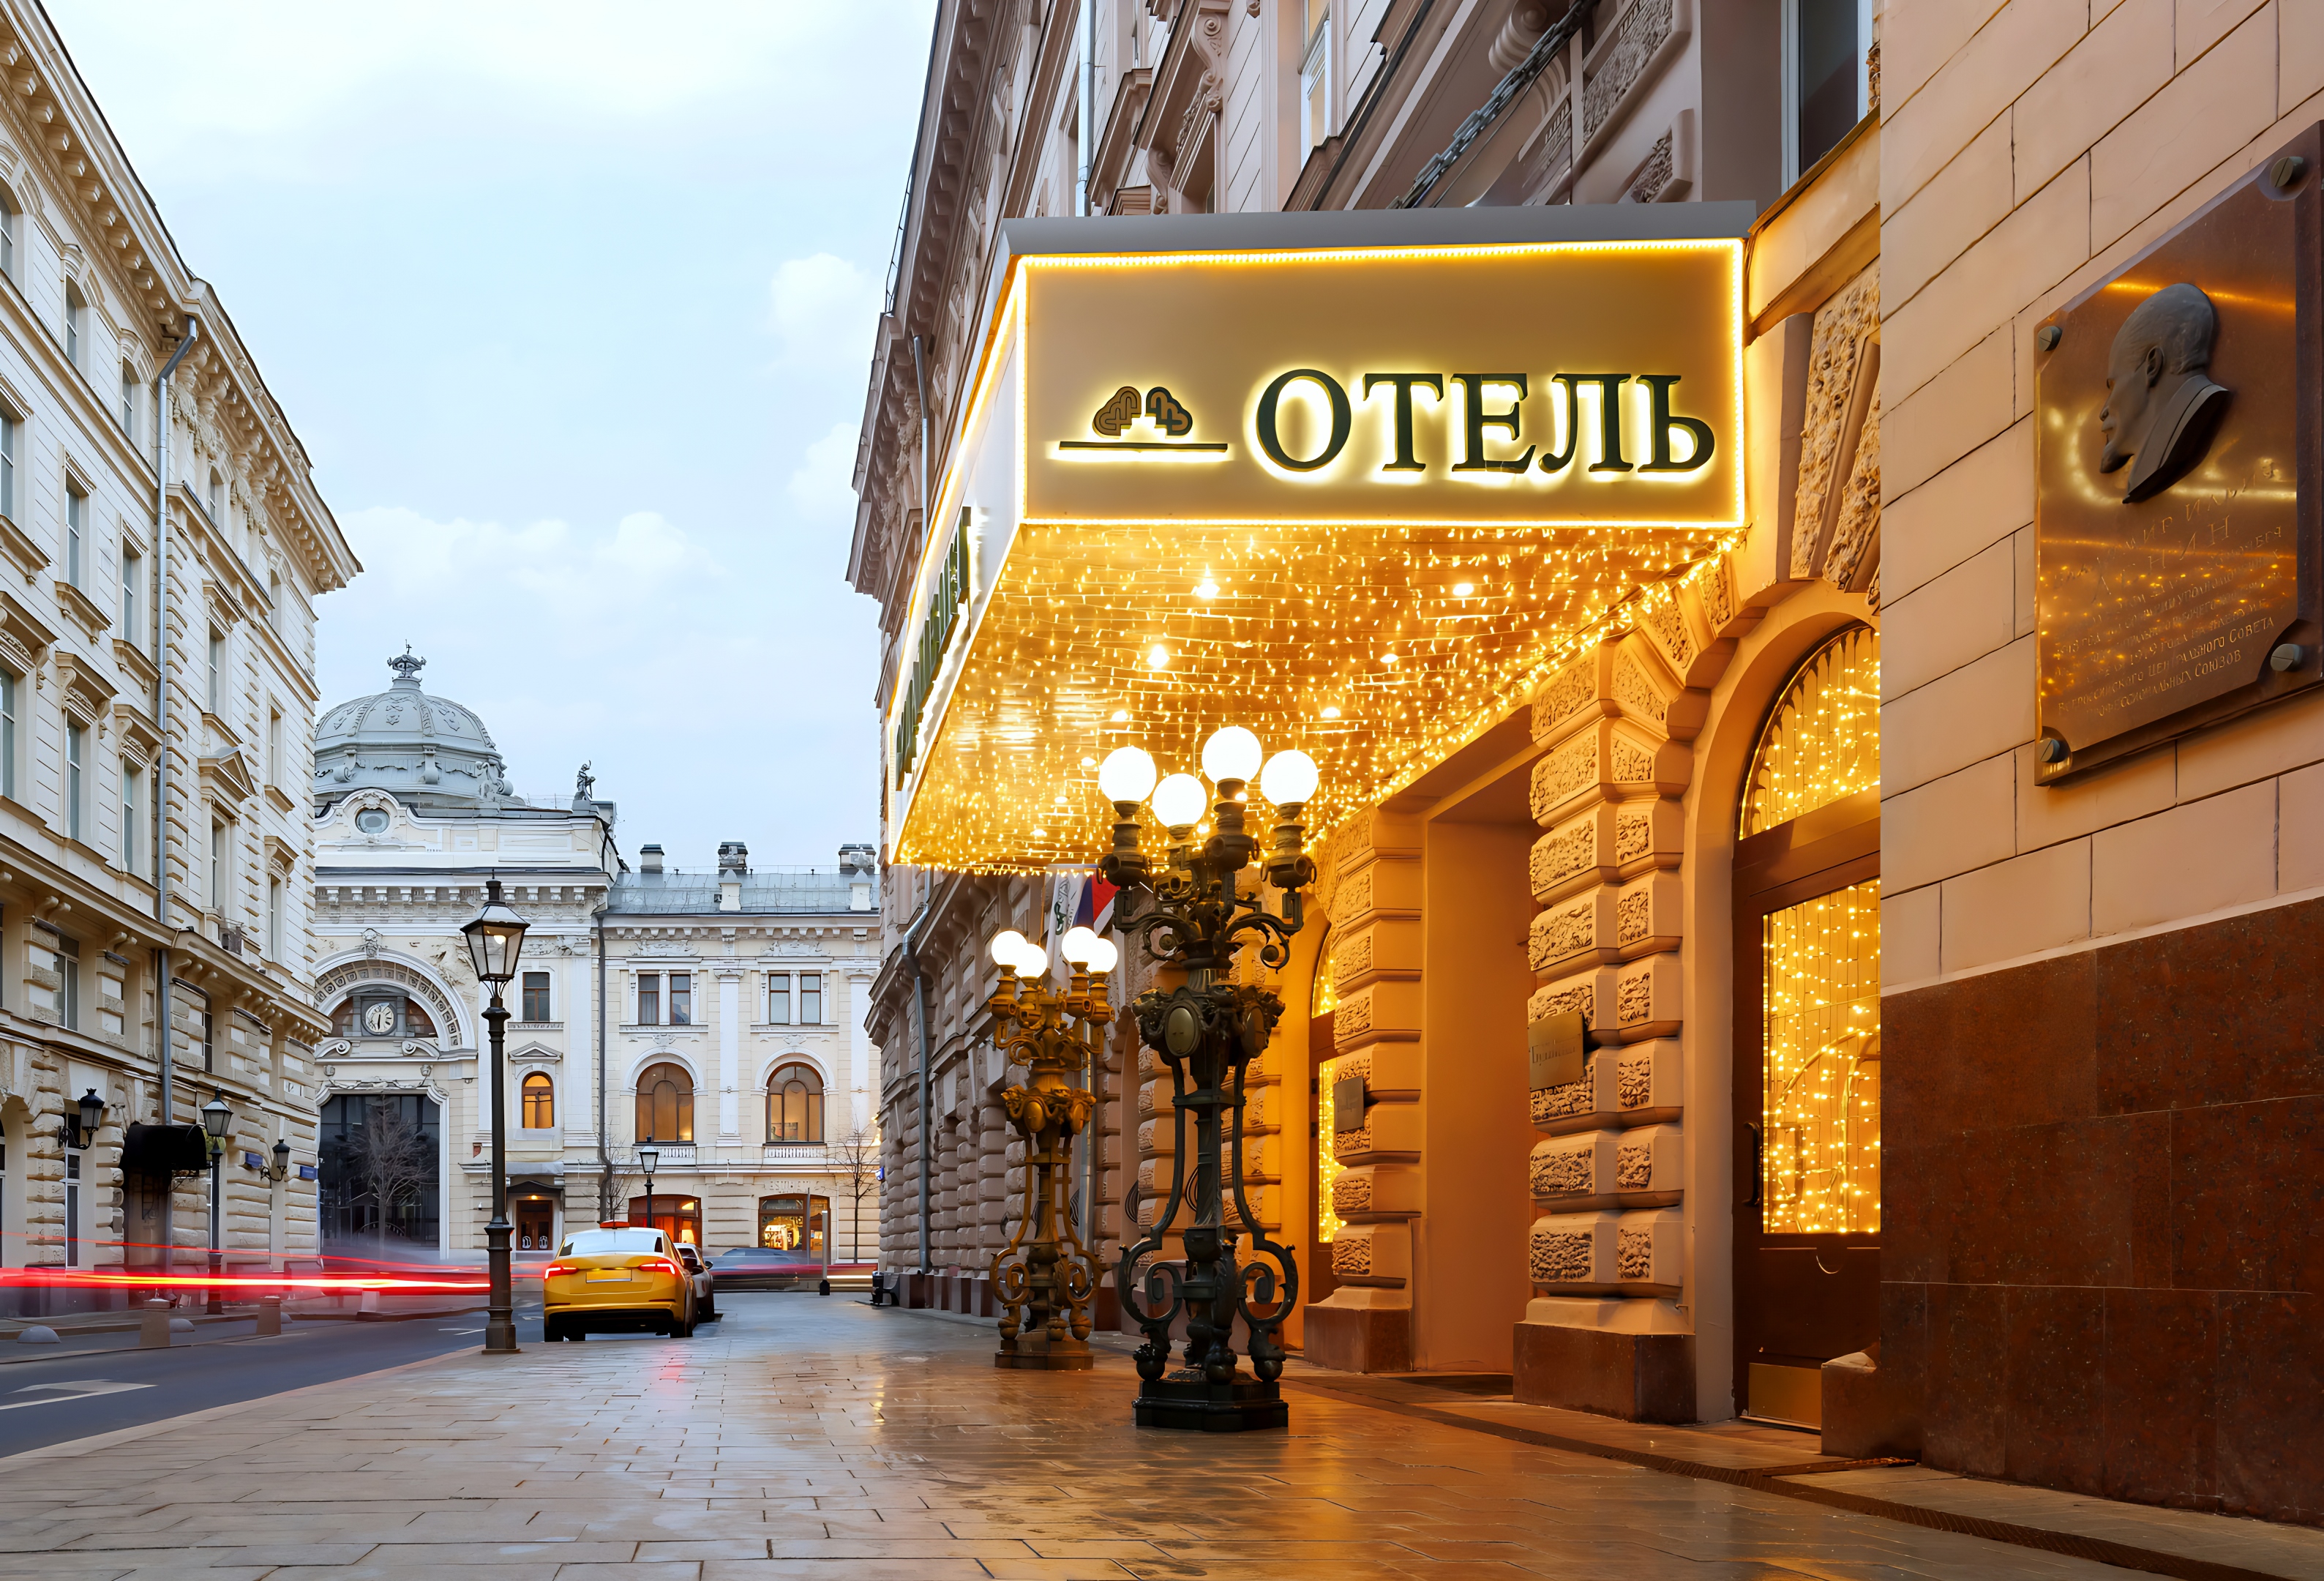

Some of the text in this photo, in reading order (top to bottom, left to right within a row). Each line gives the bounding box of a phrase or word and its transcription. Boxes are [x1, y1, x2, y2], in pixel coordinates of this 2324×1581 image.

[1256, 369, 1715, 474] ОТЕЛЬ
[2227, 526, 2281, 561] ОЯБРЯ
[2148, 637, 2225, 677] ЦЕНРАЛЬНОГО
[2229, 616, 2274, 643] СОВЕТА
[2194, 649, 2241, 677] СОЮЗОВ
